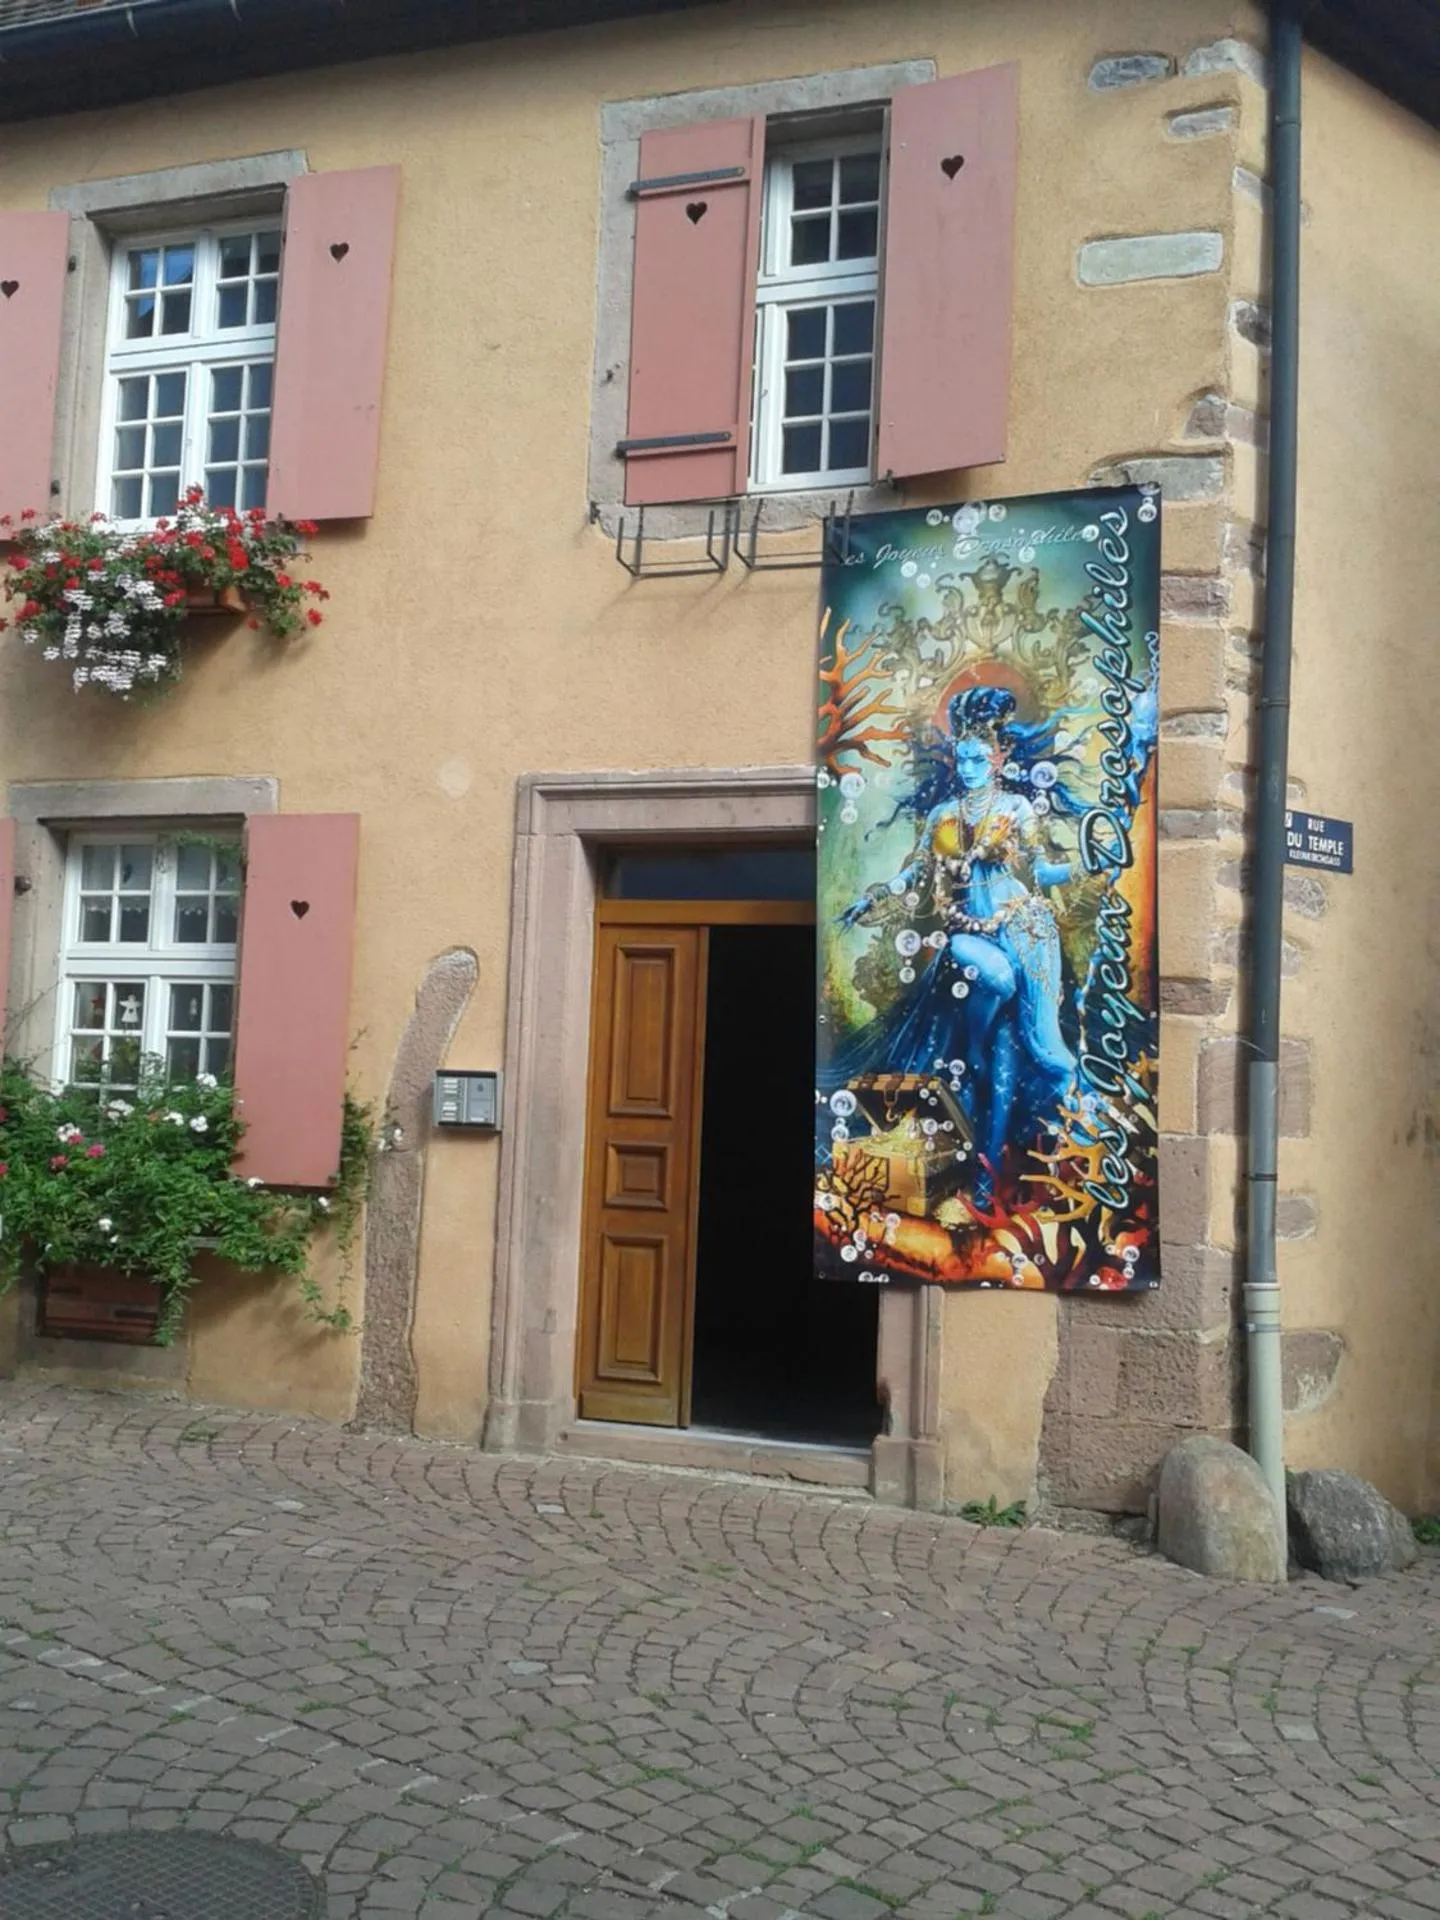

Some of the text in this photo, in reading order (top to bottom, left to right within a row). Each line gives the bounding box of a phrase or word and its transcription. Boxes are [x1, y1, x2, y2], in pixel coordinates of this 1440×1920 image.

[1078, 506, 1145, 873] Drosophiles
[1286, 832, 1343, 855] DU TEMPLE
[1307, 818, 1325, 832] RUE
[1079, 890, 1148, 1101] Joyeux
